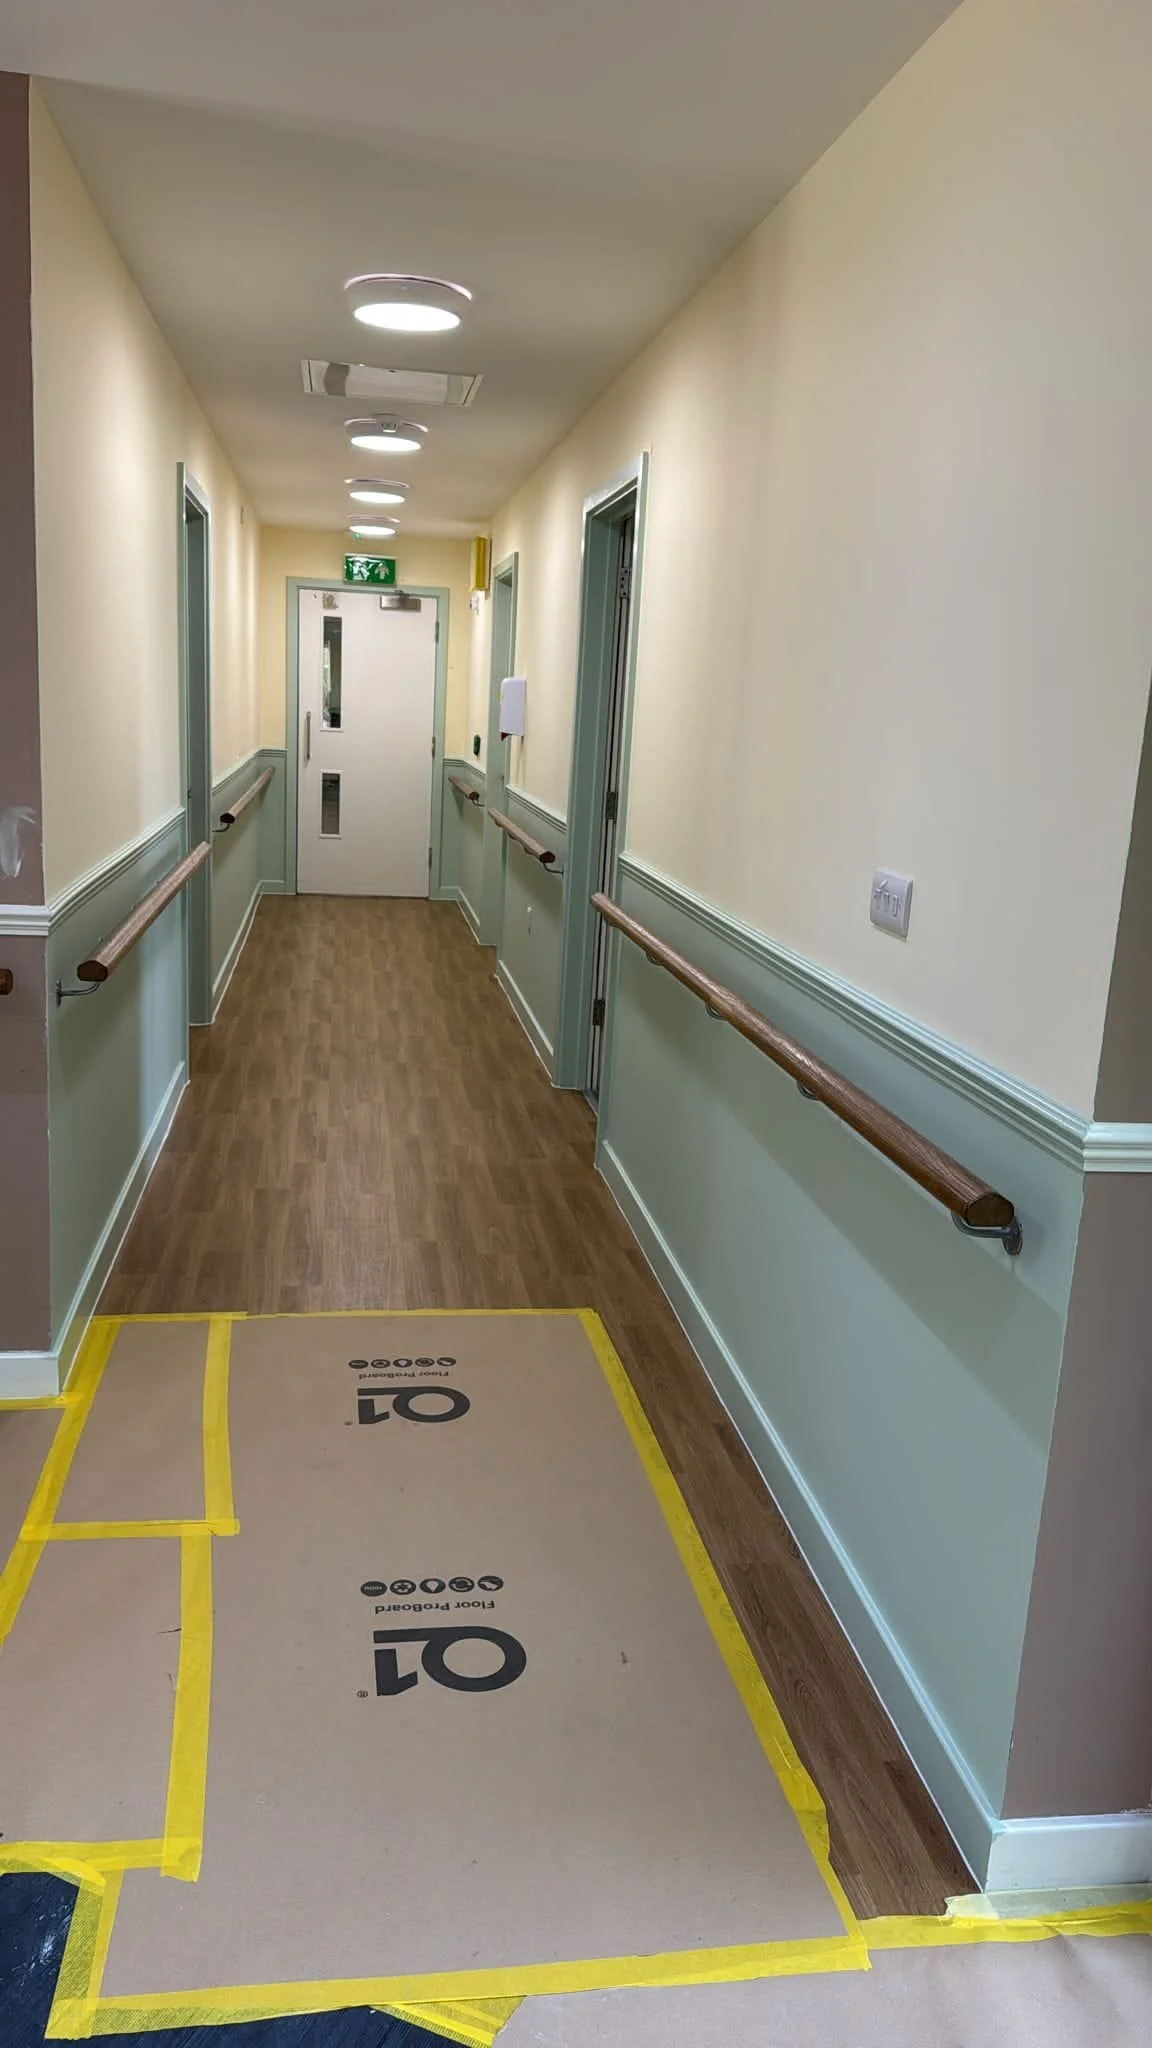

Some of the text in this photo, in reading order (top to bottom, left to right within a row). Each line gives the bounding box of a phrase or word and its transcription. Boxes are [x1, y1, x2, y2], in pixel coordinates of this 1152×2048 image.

[358, 1371, 416, 1380] ProBoard
[375, 1600, 496, 1615] Floor ProBoard
